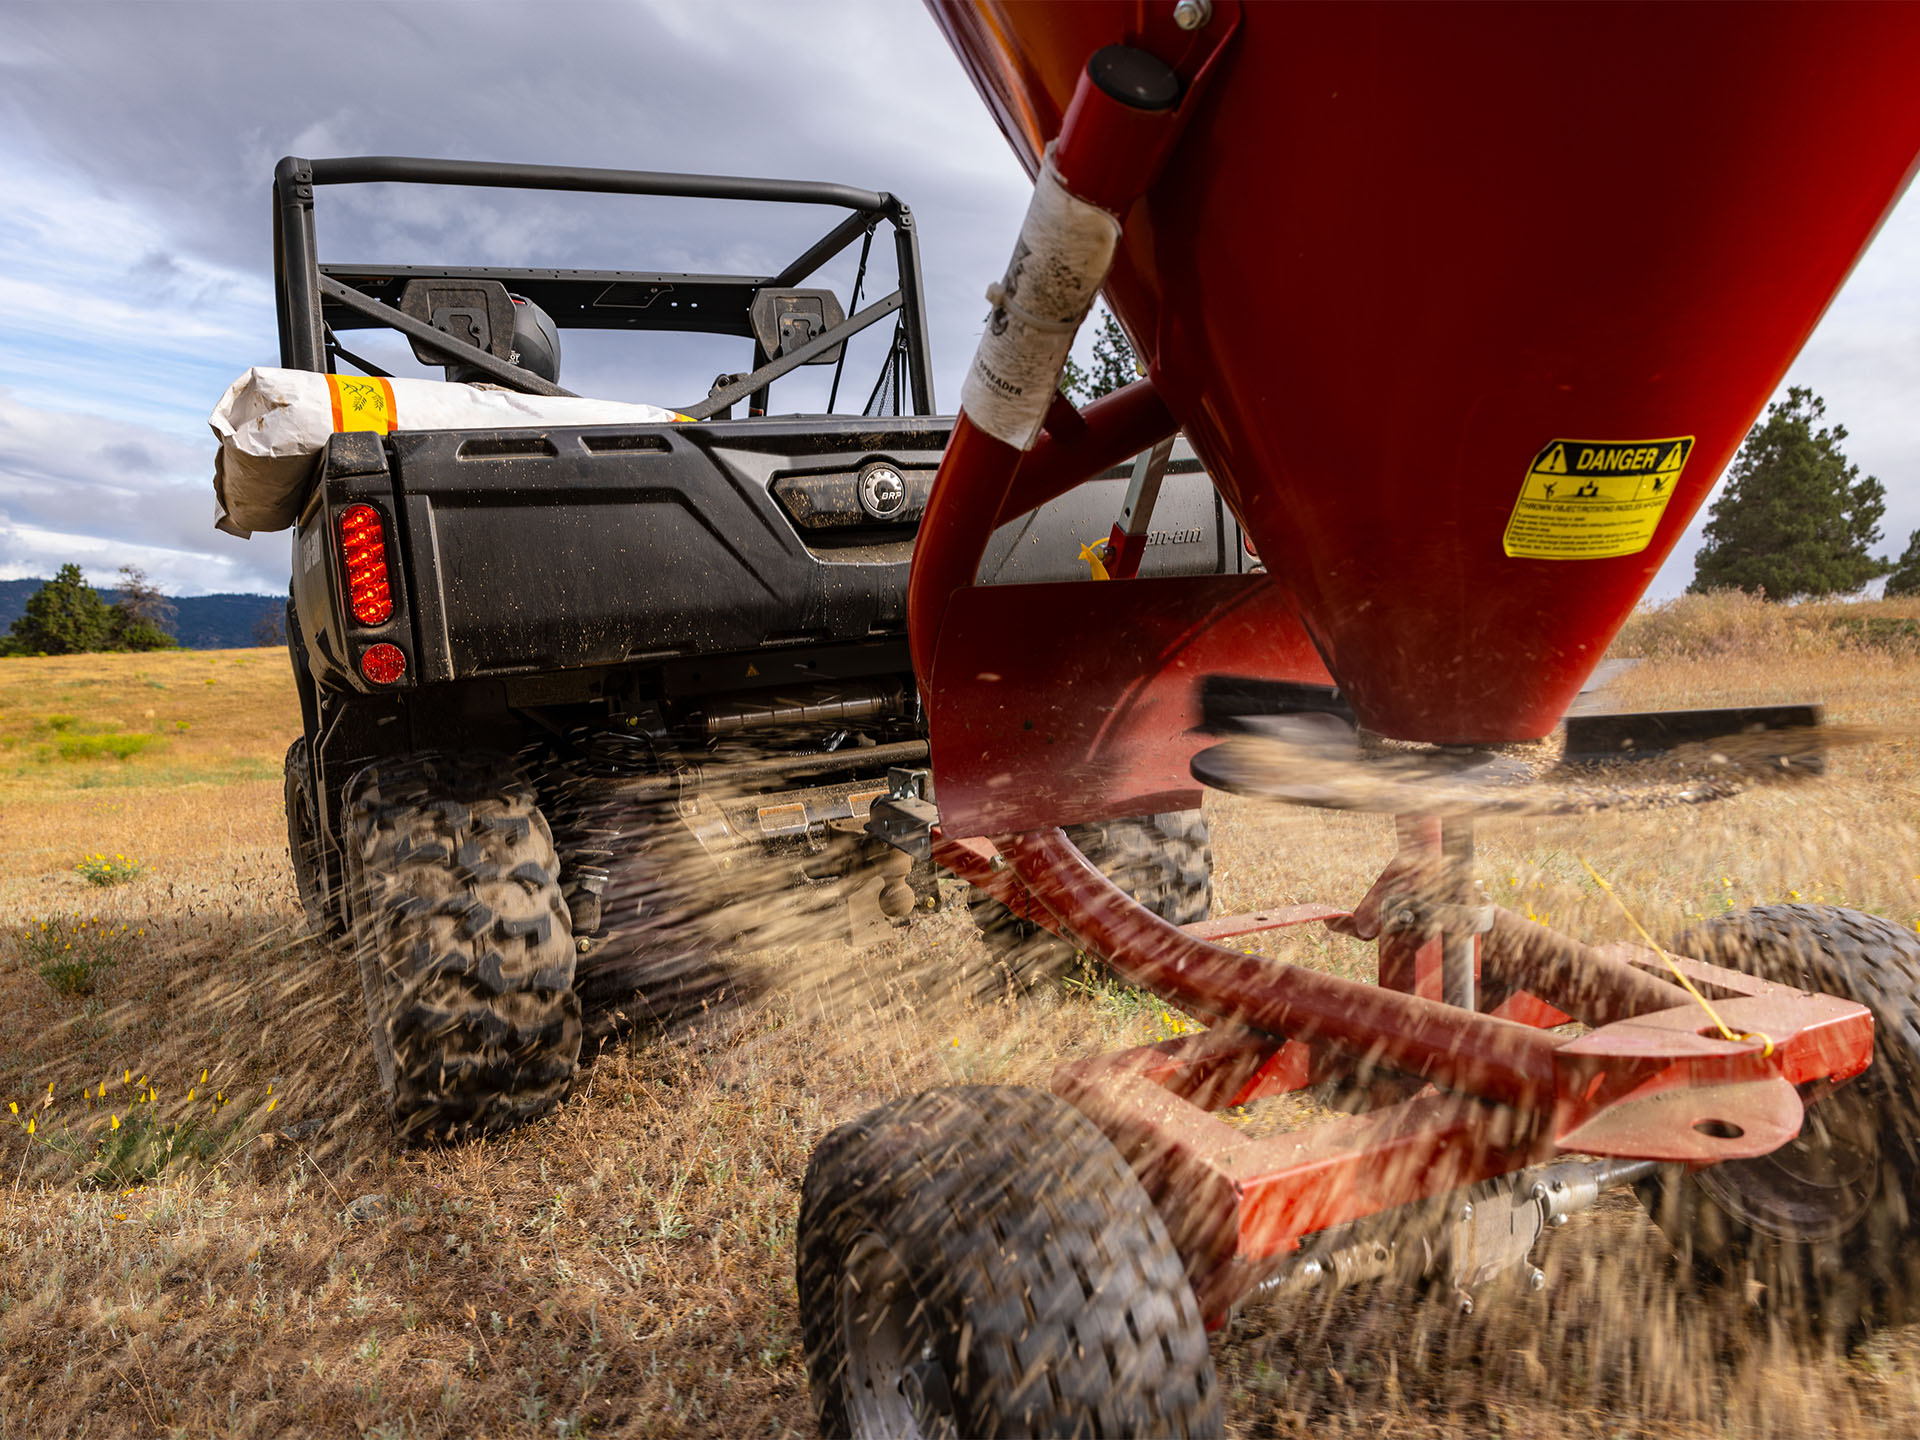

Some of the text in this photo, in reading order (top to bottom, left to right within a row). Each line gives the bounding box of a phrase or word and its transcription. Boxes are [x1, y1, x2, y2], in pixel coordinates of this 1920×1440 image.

[979, 359, 1022, 396] SPREADER
[1577, 447, 1659, 471] DANGER
[881, 491, 902, 501] BRP
[1147, 527, 1203, 546] an-am
